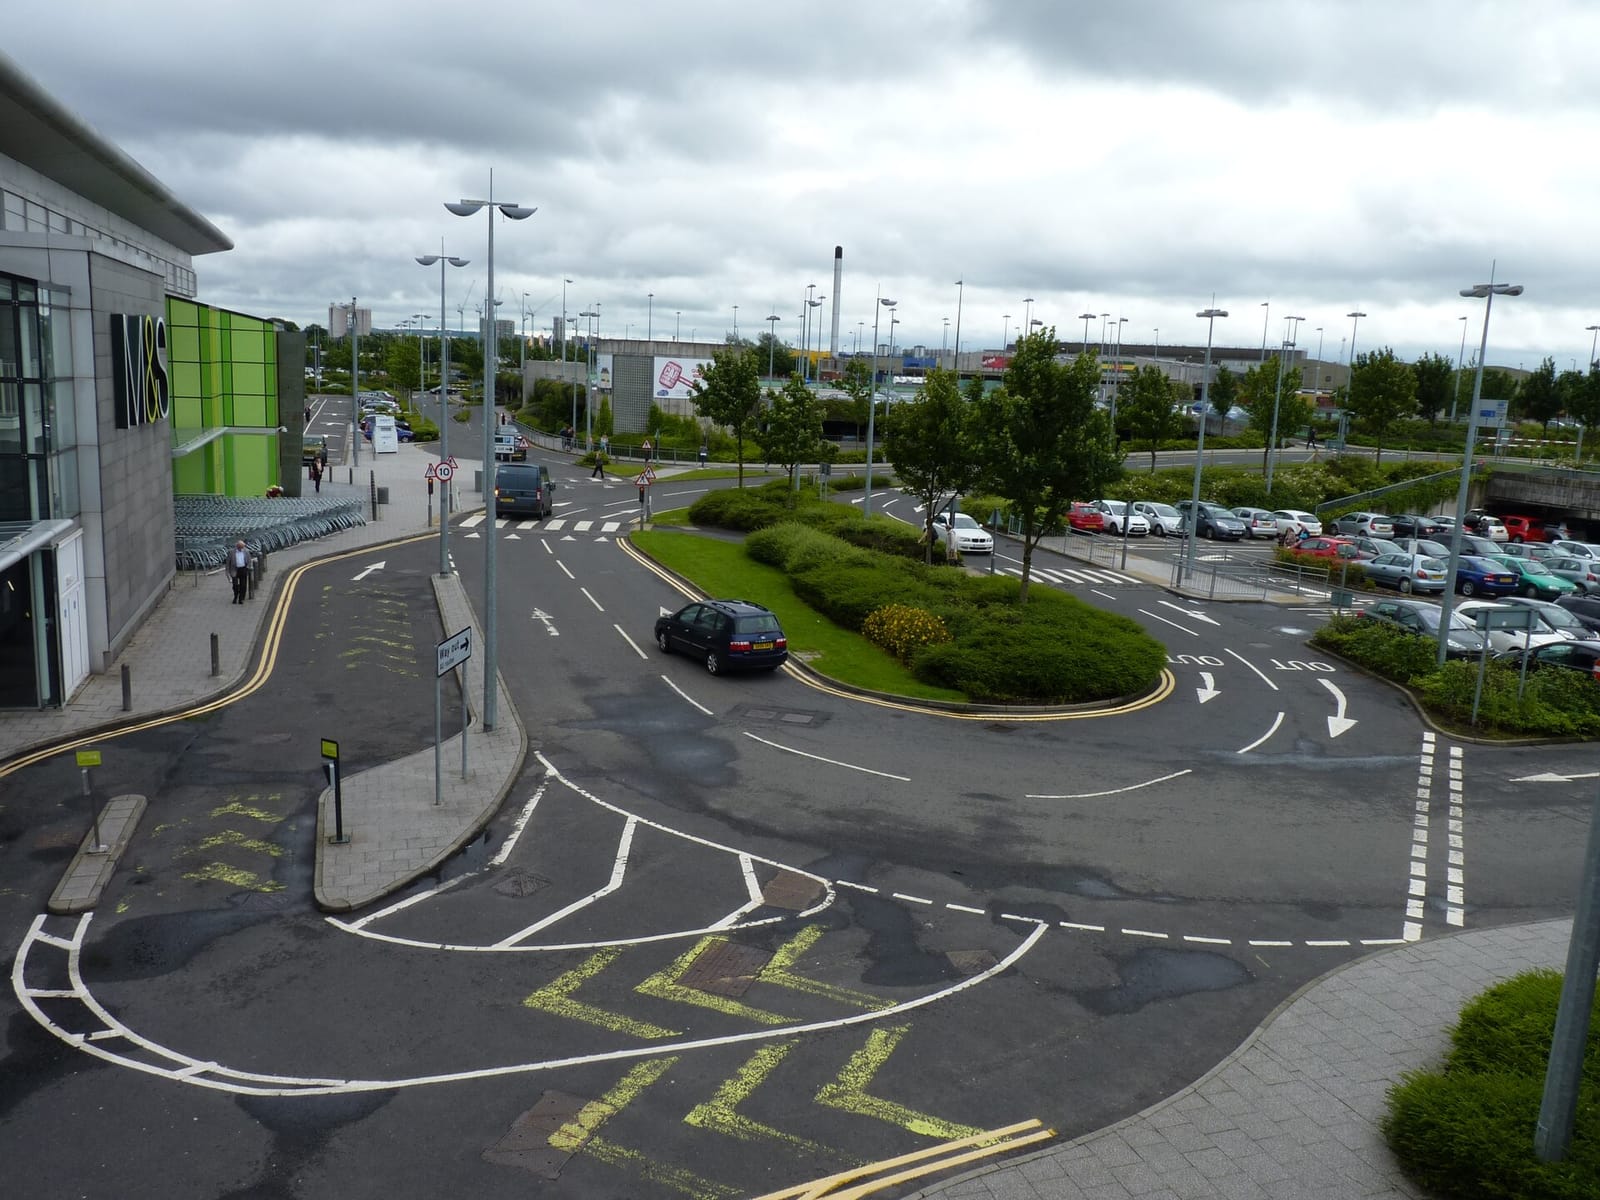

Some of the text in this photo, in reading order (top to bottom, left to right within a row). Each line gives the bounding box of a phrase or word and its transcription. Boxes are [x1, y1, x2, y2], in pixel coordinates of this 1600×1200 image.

[111, 312, 169, 429] M&S
[439, 468, 450, 476] 10
[1167, 654, 1224, 666] OUT
[1270, 659, 1336, 672] OUT
